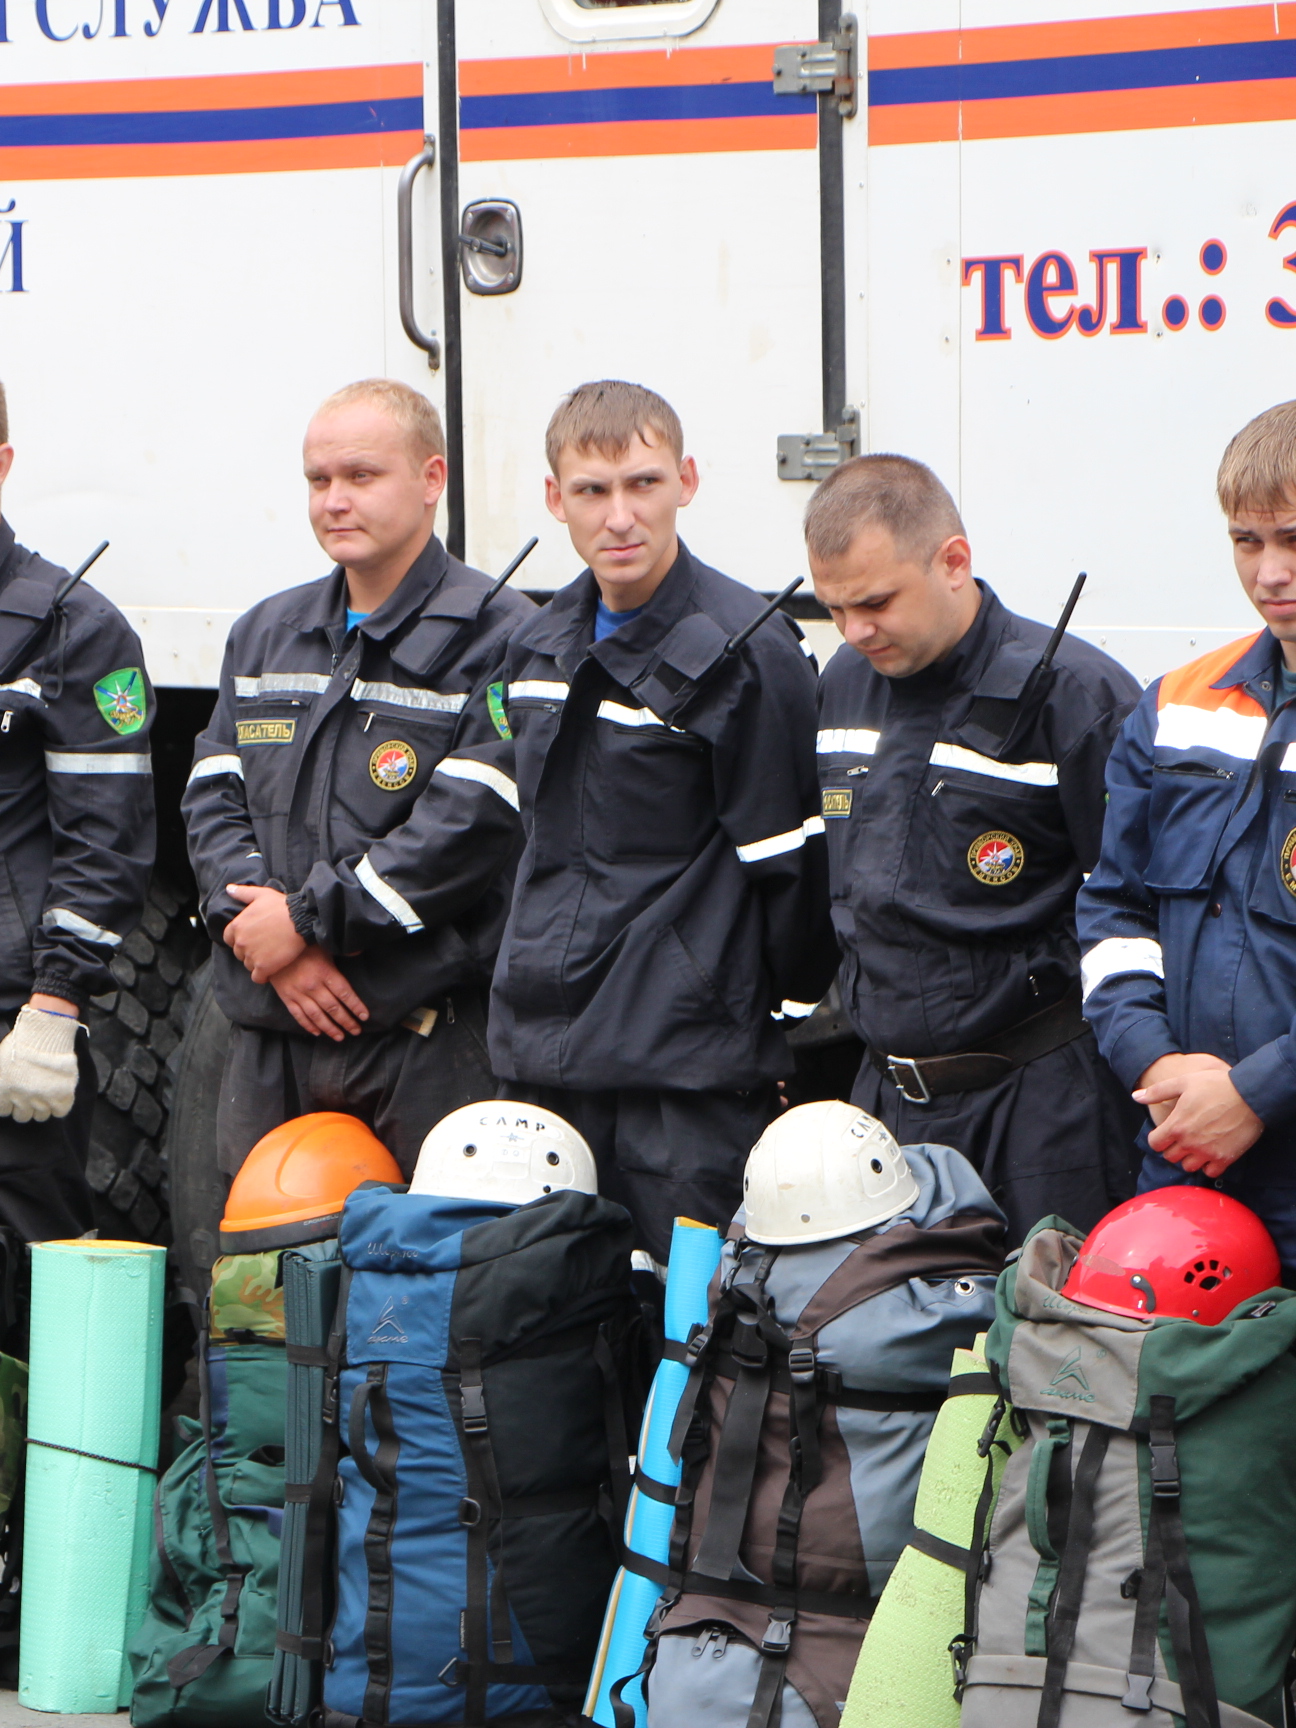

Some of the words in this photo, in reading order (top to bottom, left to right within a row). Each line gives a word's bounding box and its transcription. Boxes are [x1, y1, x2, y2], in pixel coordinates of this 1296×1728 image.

[960, 237, 1229, 342] тел.:
[237, 723, 291, 740] ПАСАТЕЛЬ
[479, 1116, 546, 1132] CAMP
